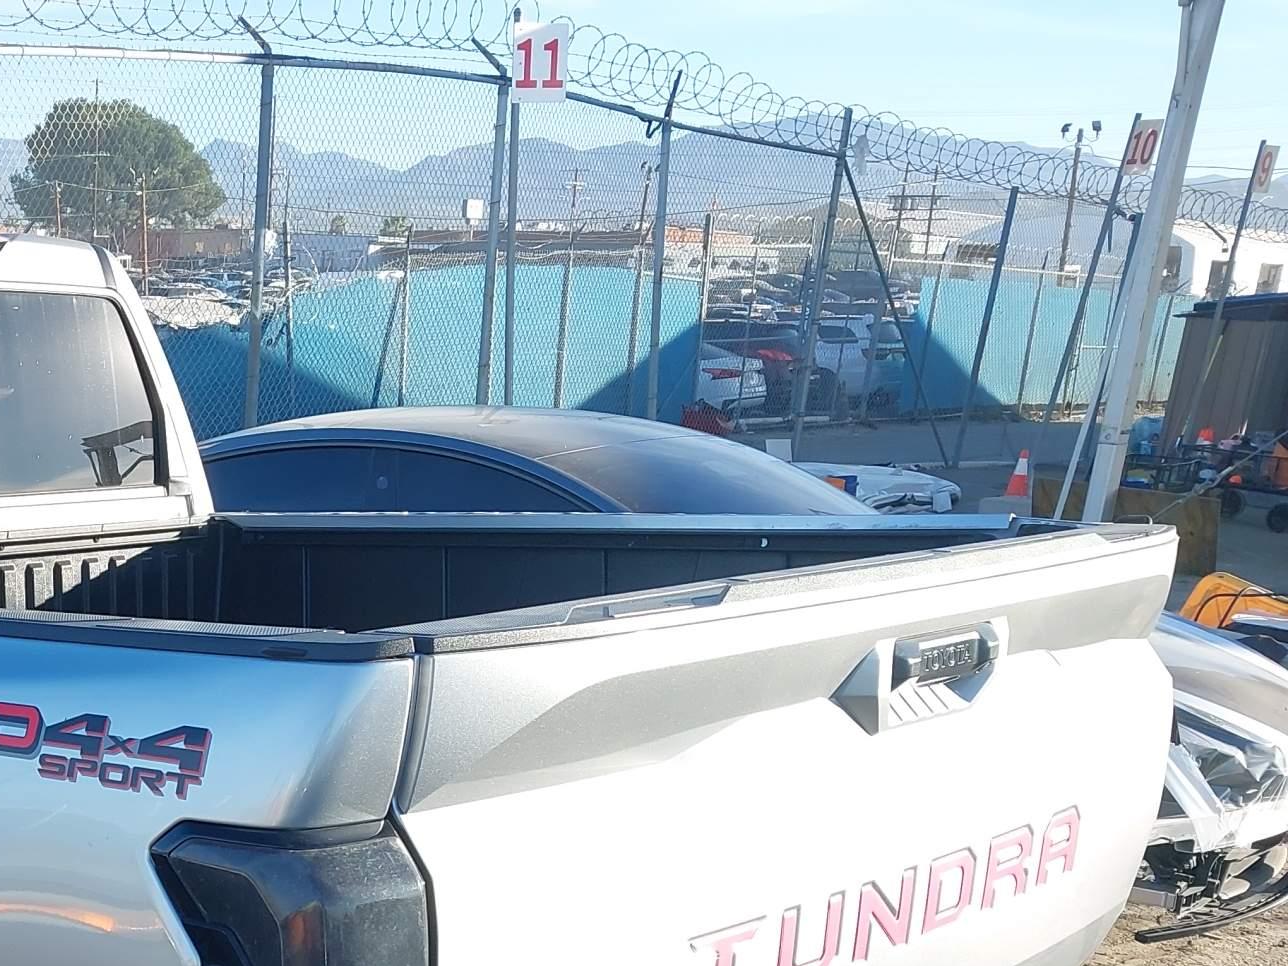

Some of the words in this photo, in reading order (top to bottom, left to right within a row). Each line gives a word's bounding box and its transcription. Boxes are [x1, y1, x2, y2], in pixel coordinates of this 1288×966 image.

[515, 37, 564, 89] 11
[1126, 128, 1158, 165] 10
[1259, 151, 1273, 187] 9
[923, 643, 972, 672] TOYOTA
[37, 753, 203, 800] SPORT
